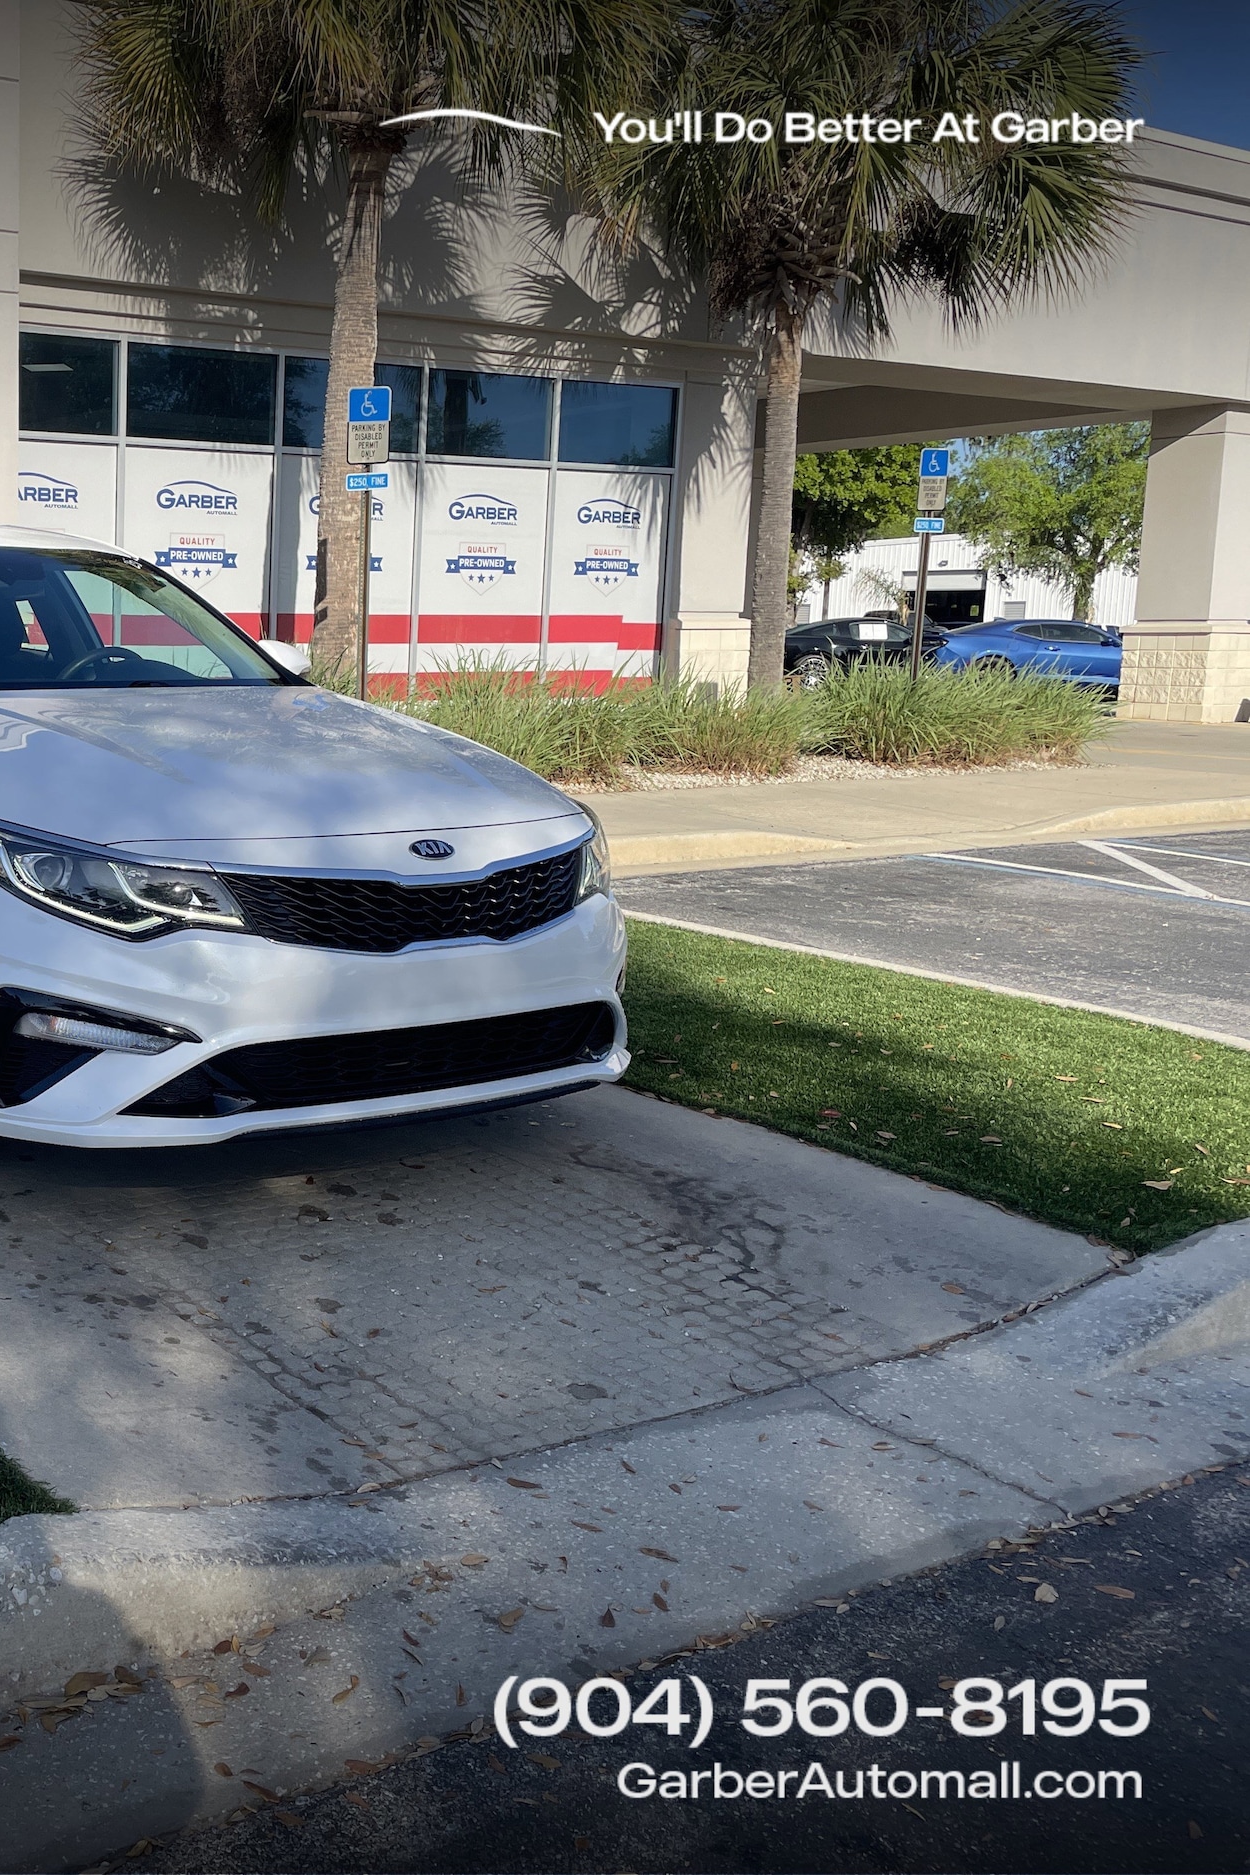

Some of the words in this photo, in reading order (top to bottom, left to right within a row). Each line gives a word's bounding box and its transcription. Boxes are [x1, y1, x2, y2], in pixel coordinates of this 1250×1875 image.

[351, 424, 376, 432] PARKING
[378, 423, 386, 431] BY
[354, 432, 383, 441] DISABLED
[358, 440, 379, 449] PERMIT
[360, 450, 376, 458] ONLY
[349, 476, 368, 488] $250
[371, 475, 386, 486] FINE
[18, 486, 78, 503] RBER
[156, 488, 238, 510] GARBER
[449, 501, 518, 521] GARBER
[577, 506, 641, 525] GARBER
[179, 536, 216, 546] QUALITY
[467, 545, 498, 554] QUALITY
[593, 548, 622, 556] QUALITY
[170, 550, 224, 561] PRE-OWNED
[458, 558, 505, 568] PRE-OWNED
[586, 560, 629, 570] PRE-OWNED
[414, 841, 452, 856] KIA
